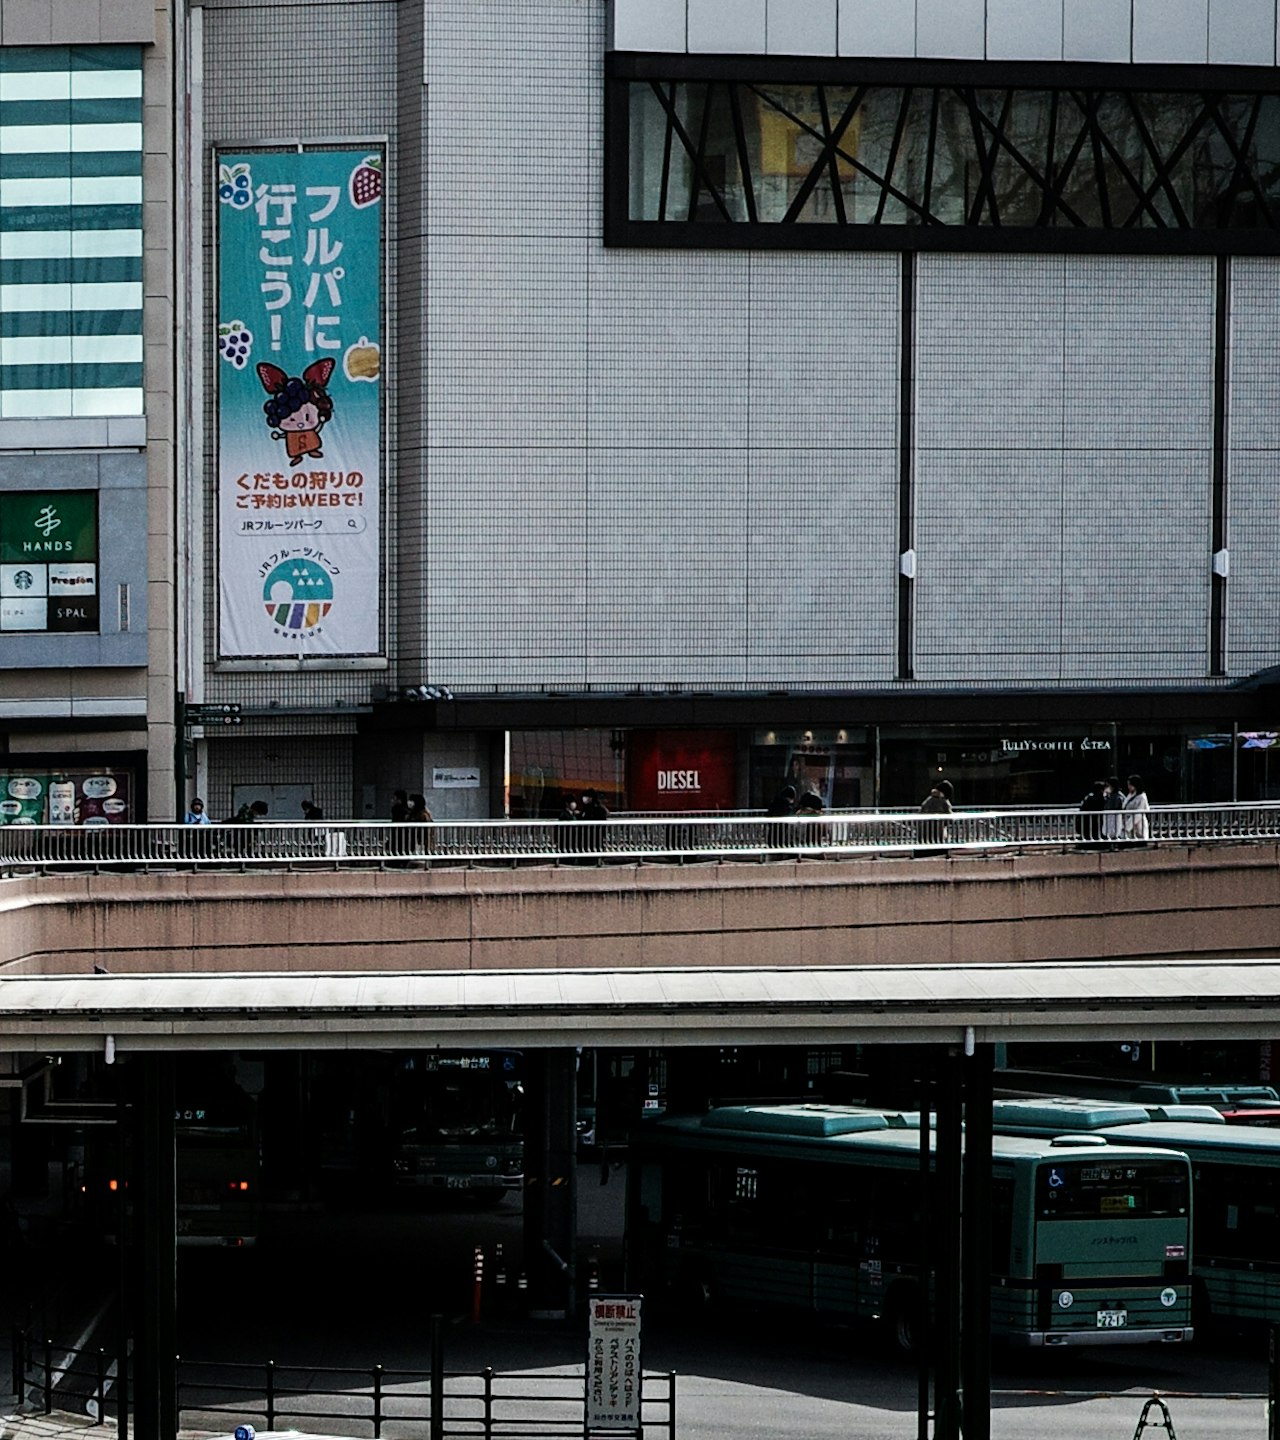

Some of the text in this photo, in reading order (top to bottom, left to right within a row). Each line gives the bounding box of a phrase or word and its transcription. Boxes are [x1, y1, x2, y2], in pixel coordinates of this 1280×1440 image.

[255, 182, 297, 351] 行こう！
[302, 186, 344, 351] フルパに
[236, 470, 364, 490] くだもの狩りの
[241, 519, 324, 531] JRフルーツパーク
[23, 541, 73, 552] HANDS
[258, 547, 342, 579] JRフルーツパーク
[657, 770, 701, 790] DIESEL
[1090, 1235, 1138, 1245] ノンステップバス
[594, 1304, 637, 1320] 横断禁止
